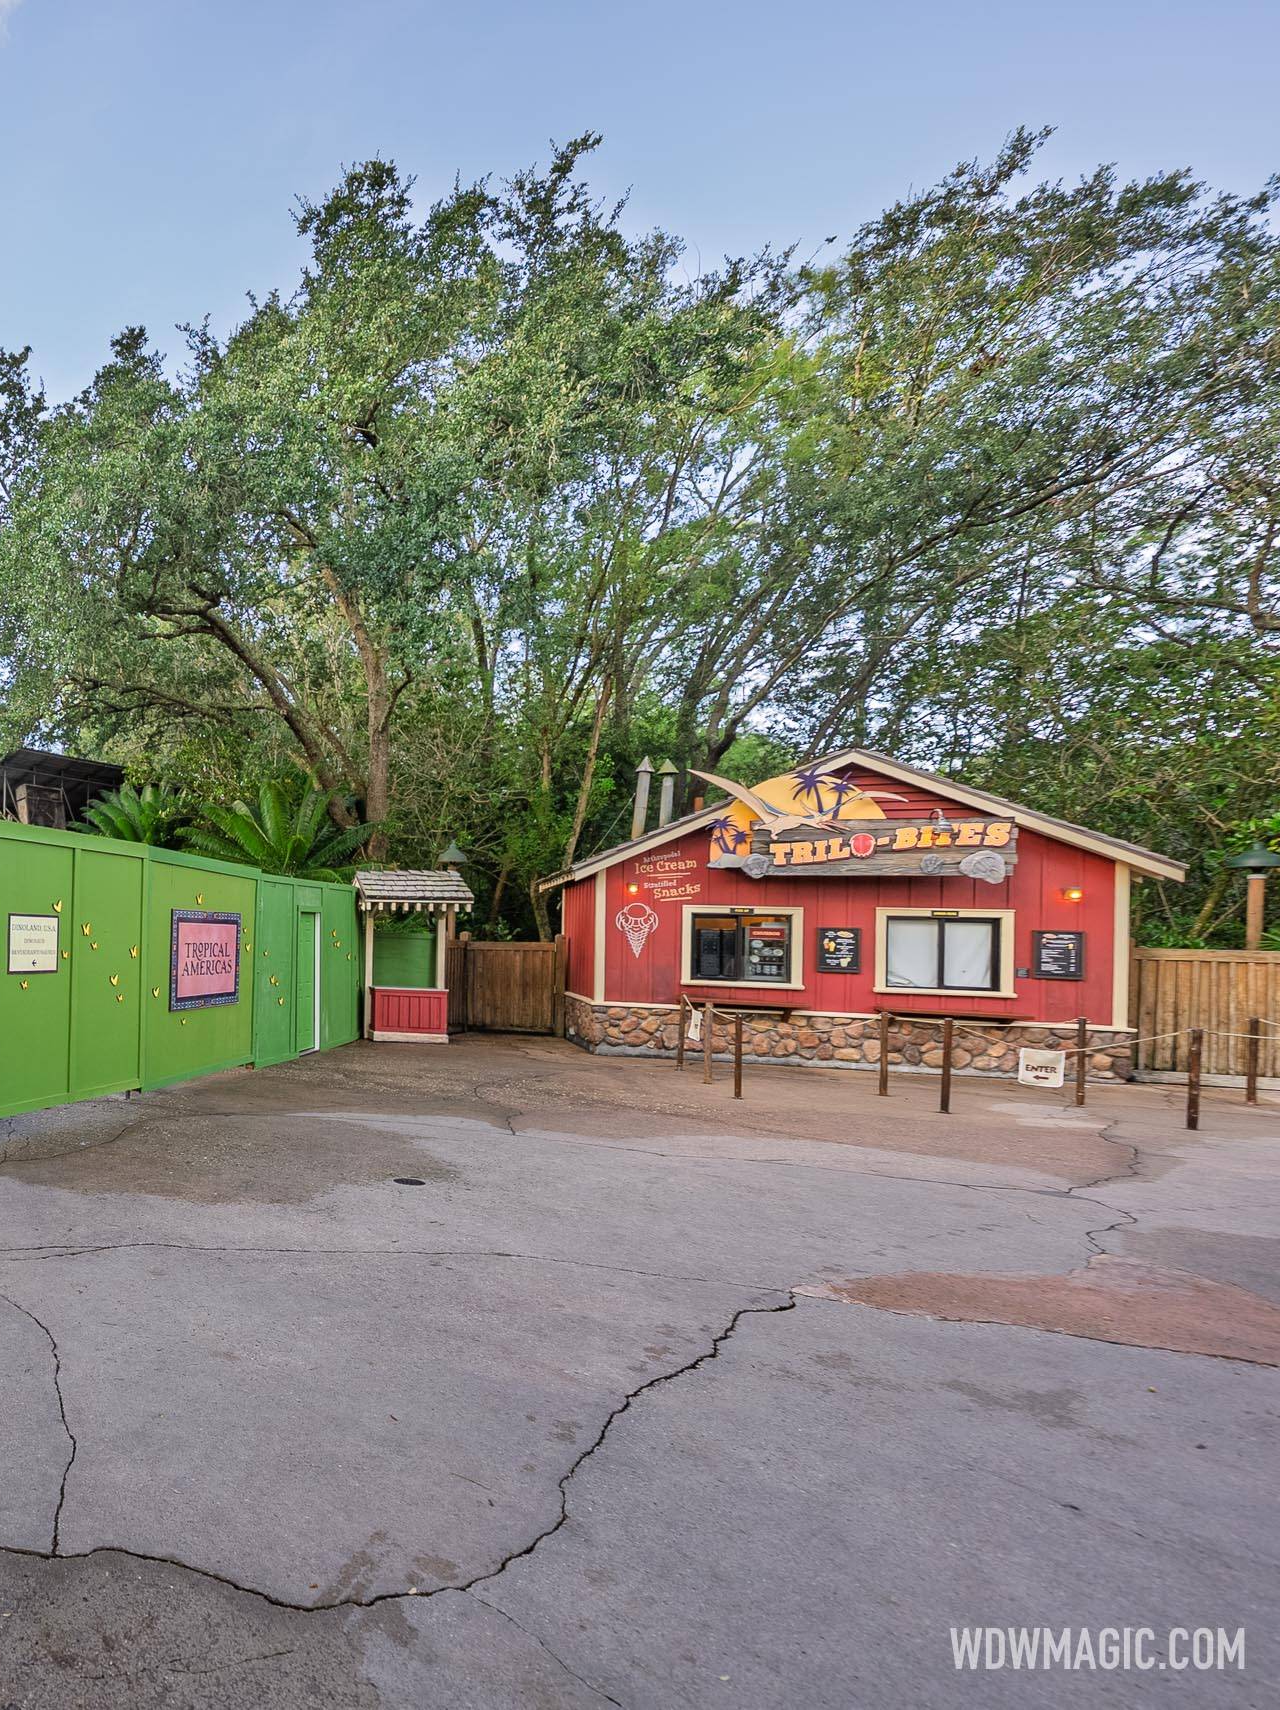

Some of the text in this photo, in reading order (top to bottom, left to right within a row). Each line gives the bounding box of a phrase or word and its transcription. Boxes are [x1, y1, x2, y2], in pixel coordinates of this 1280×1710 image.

[634, 859, 697, 875] Ice Cream
[643, 879, 677, 889] Stratified
[653, 883, 701, 899] Snacks
[184, 942, 231, 961] TROPICAL
[181, 959, 233, 977] AMERICAS
[1025, 1063, 1057, 1073] ENTER
